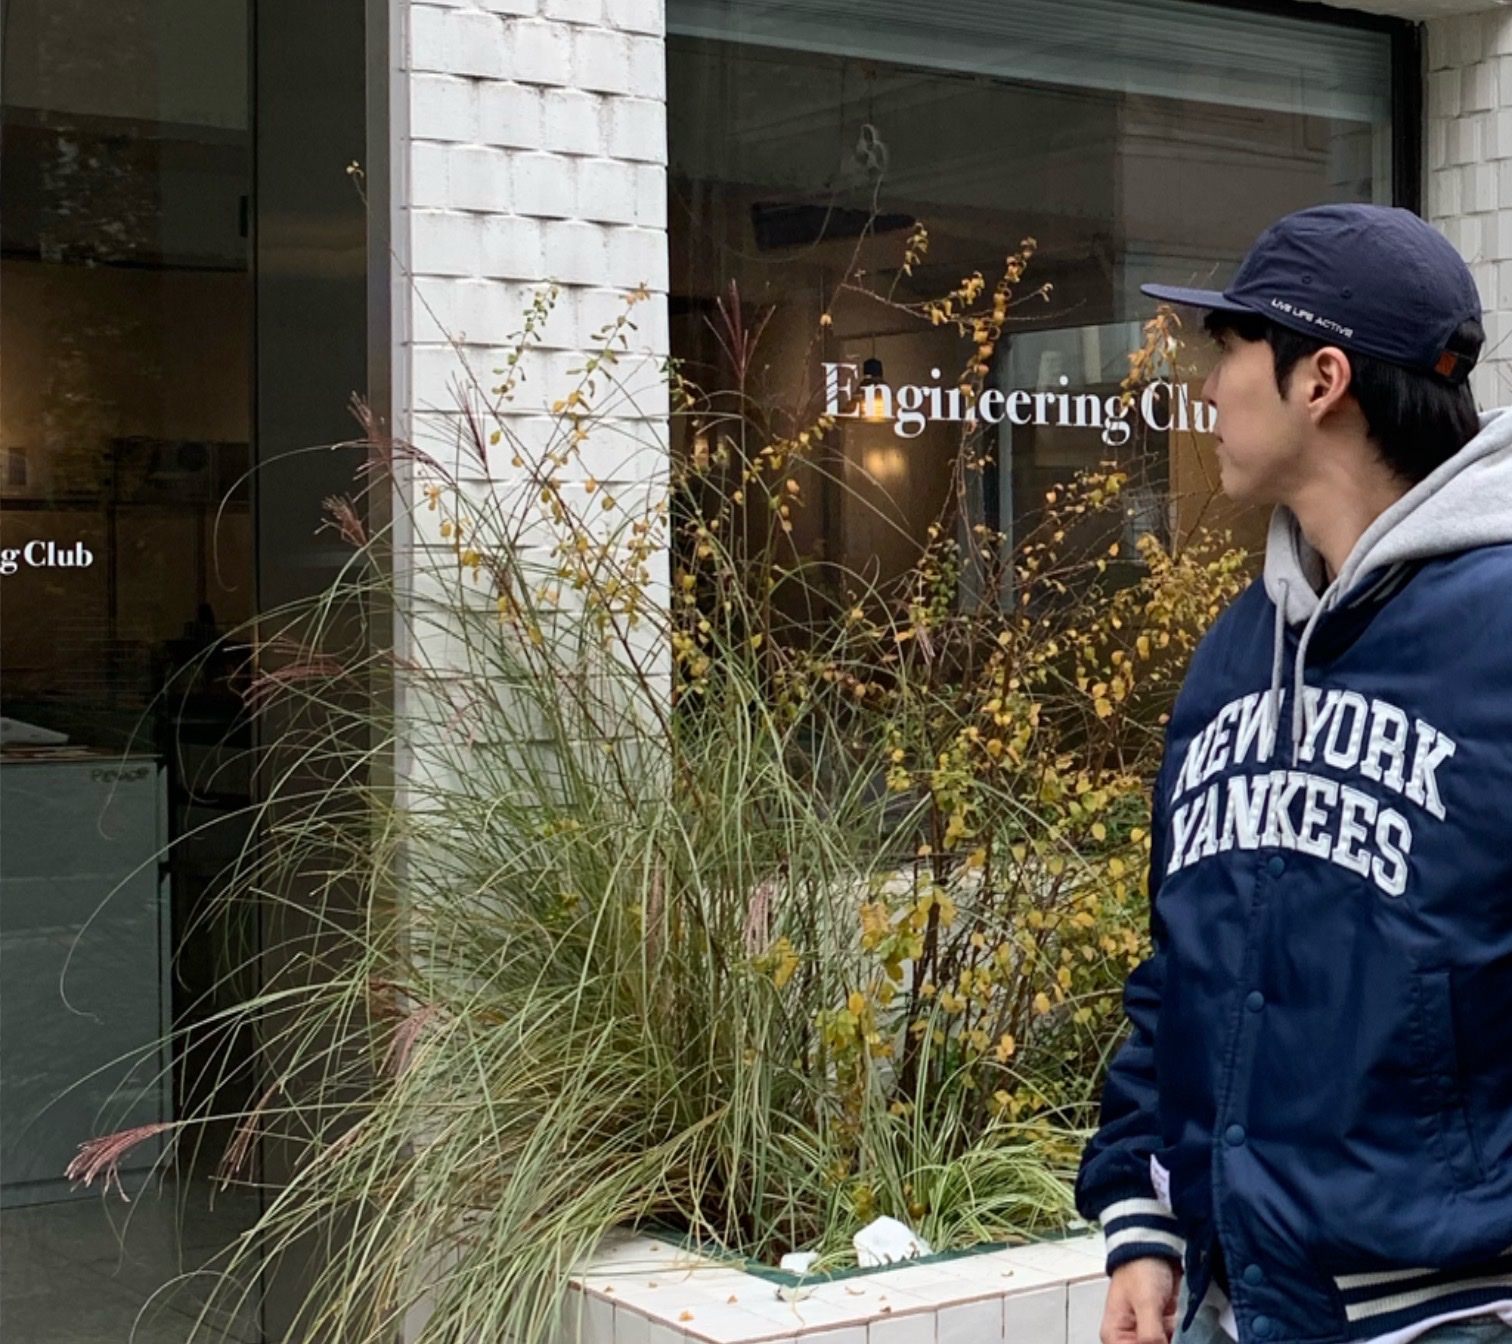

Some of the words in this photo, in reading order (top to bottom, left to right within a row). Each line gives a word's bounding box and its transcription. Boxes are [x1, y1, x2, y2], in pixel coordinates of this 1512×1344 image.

[1271, 297, 1292, 313] LIVE
[1292, 308, 1314, 322] LIFE
[1314, 317, 1353, 338] ACTIVE
[821, 361, 1134, 447] Engineering
[1141, 381, 1219, 434] Clu
[24, 540, 94, 568] Club
[1170, 688, 1285, 804] NEW
[1298, 684, 1457, 822] YORK
[1165, 769, 1413, 897] YANKEES
